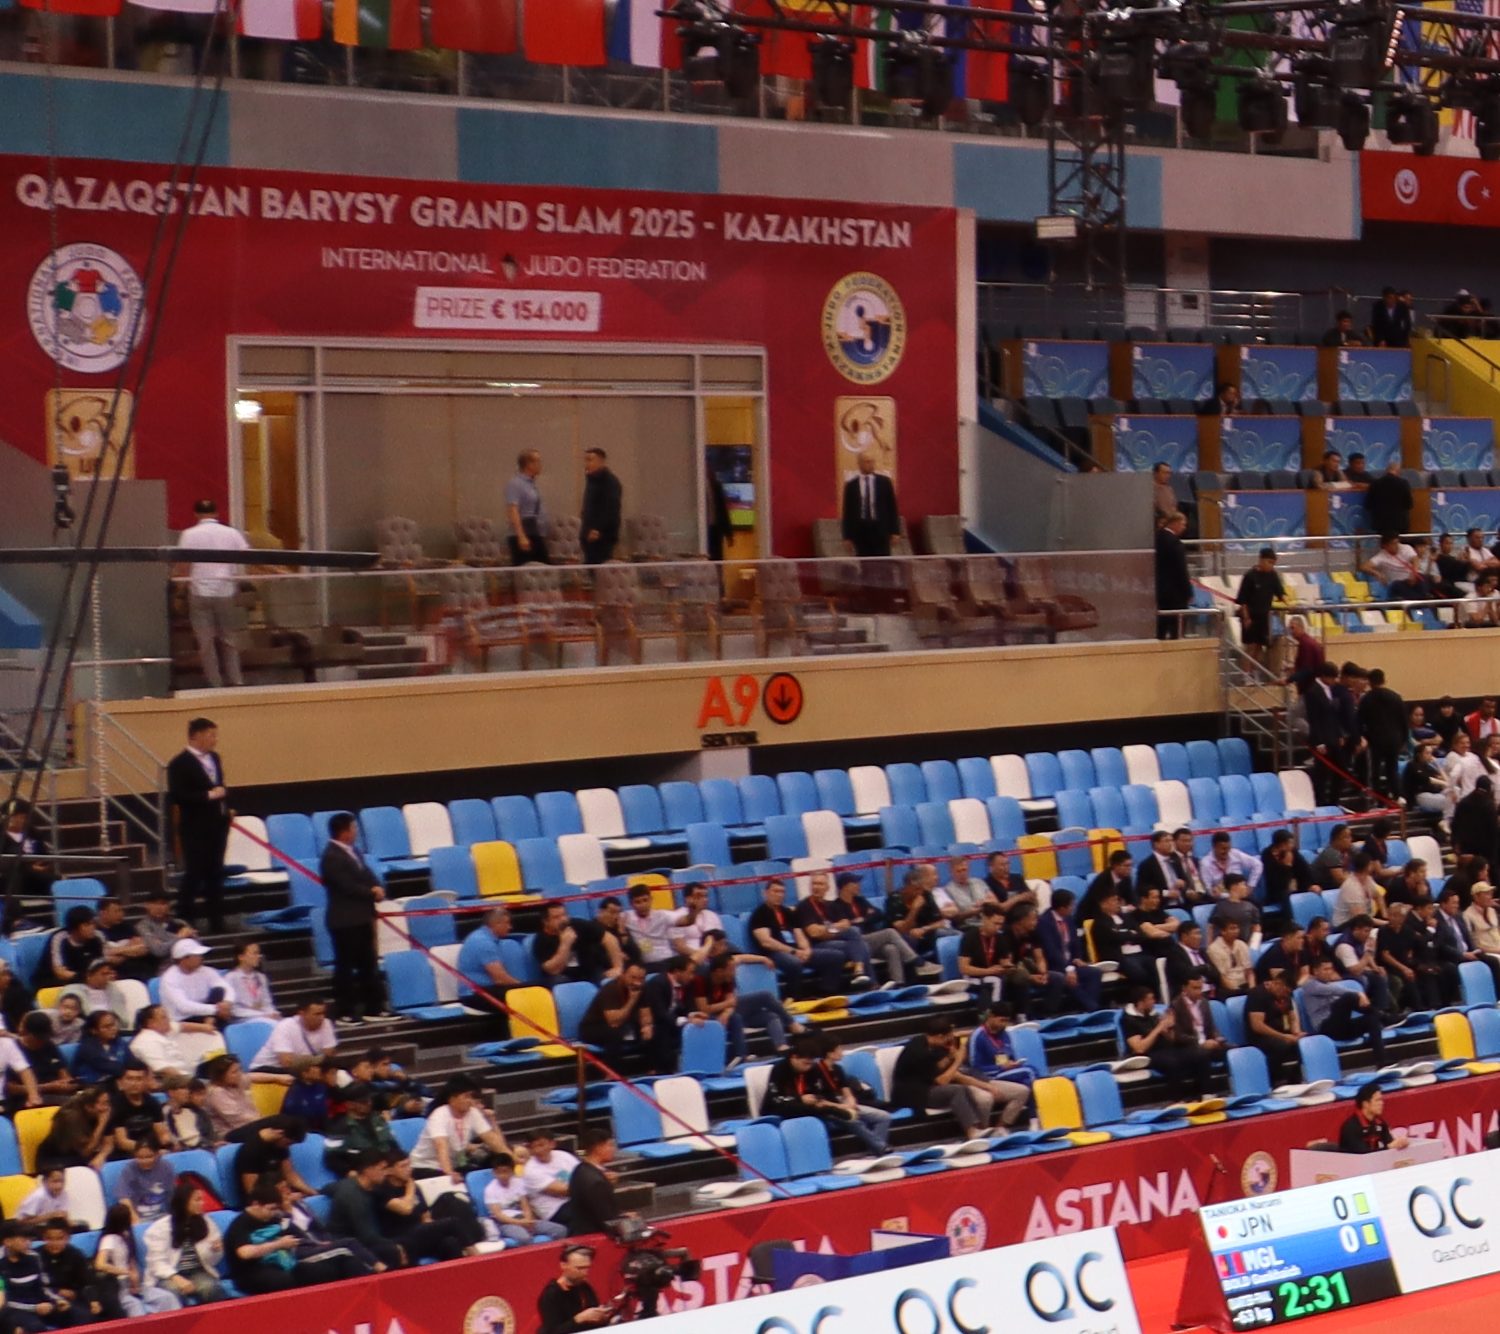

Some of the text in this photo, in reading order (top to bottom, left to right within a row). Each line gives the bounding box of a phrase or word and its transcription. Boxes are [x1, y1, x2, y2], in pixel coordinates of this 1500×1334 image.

[16, 173, 912, 248] QAZAQSTAN BARYSY GRAND SLAM 2025 KAZAKHSTAN
[323, 247, 706, 281] INTERNATIONAL JUDO FEDERATION
[427, 297, 485, 319] PRIZE
[696, 674, 760, 728] A9
[1023, 1168, 1200, 1241] ASTANA
[1243, 1246, 1284, 1271] MGL
[1340, 1226, 1360, 1253] 0
[1279, 1271, 1350, 1317] 2:31
